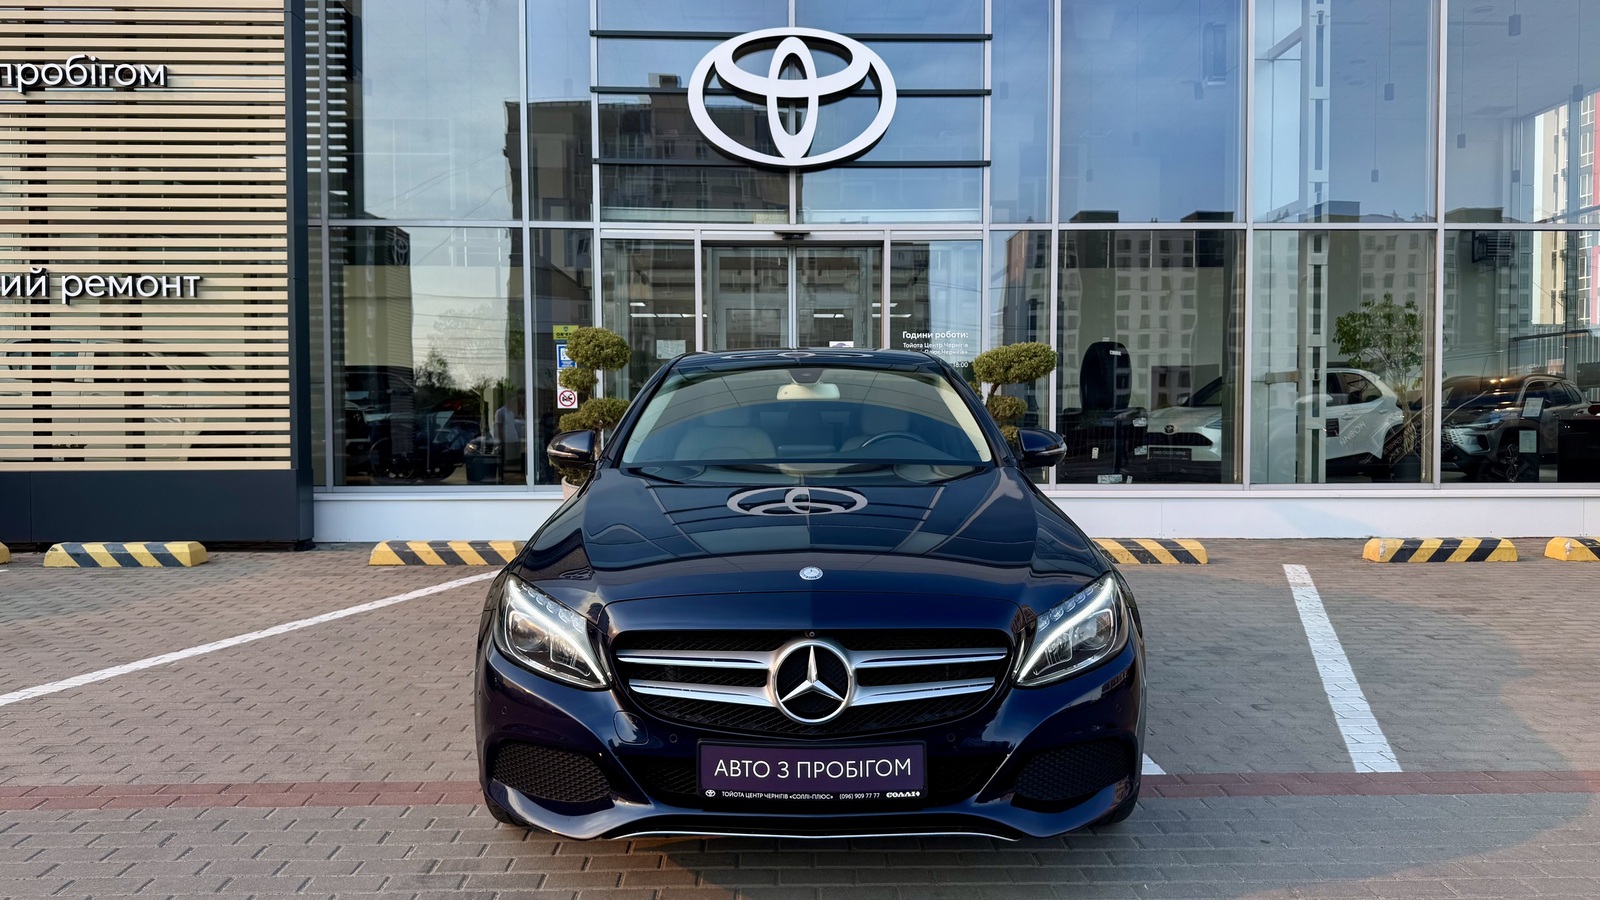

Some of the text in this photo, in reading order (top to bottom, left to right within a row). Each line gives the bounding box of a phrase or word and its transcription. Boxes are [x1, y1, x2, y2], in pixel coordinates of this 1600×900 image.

[0, 54, 167, 93] пробігом
[61, 273, 201, 304] ремонт
[902, 331, 969, 339] Години роботи:
[714, 758, 911, 779] АВТО З ПРОБІГОМ
